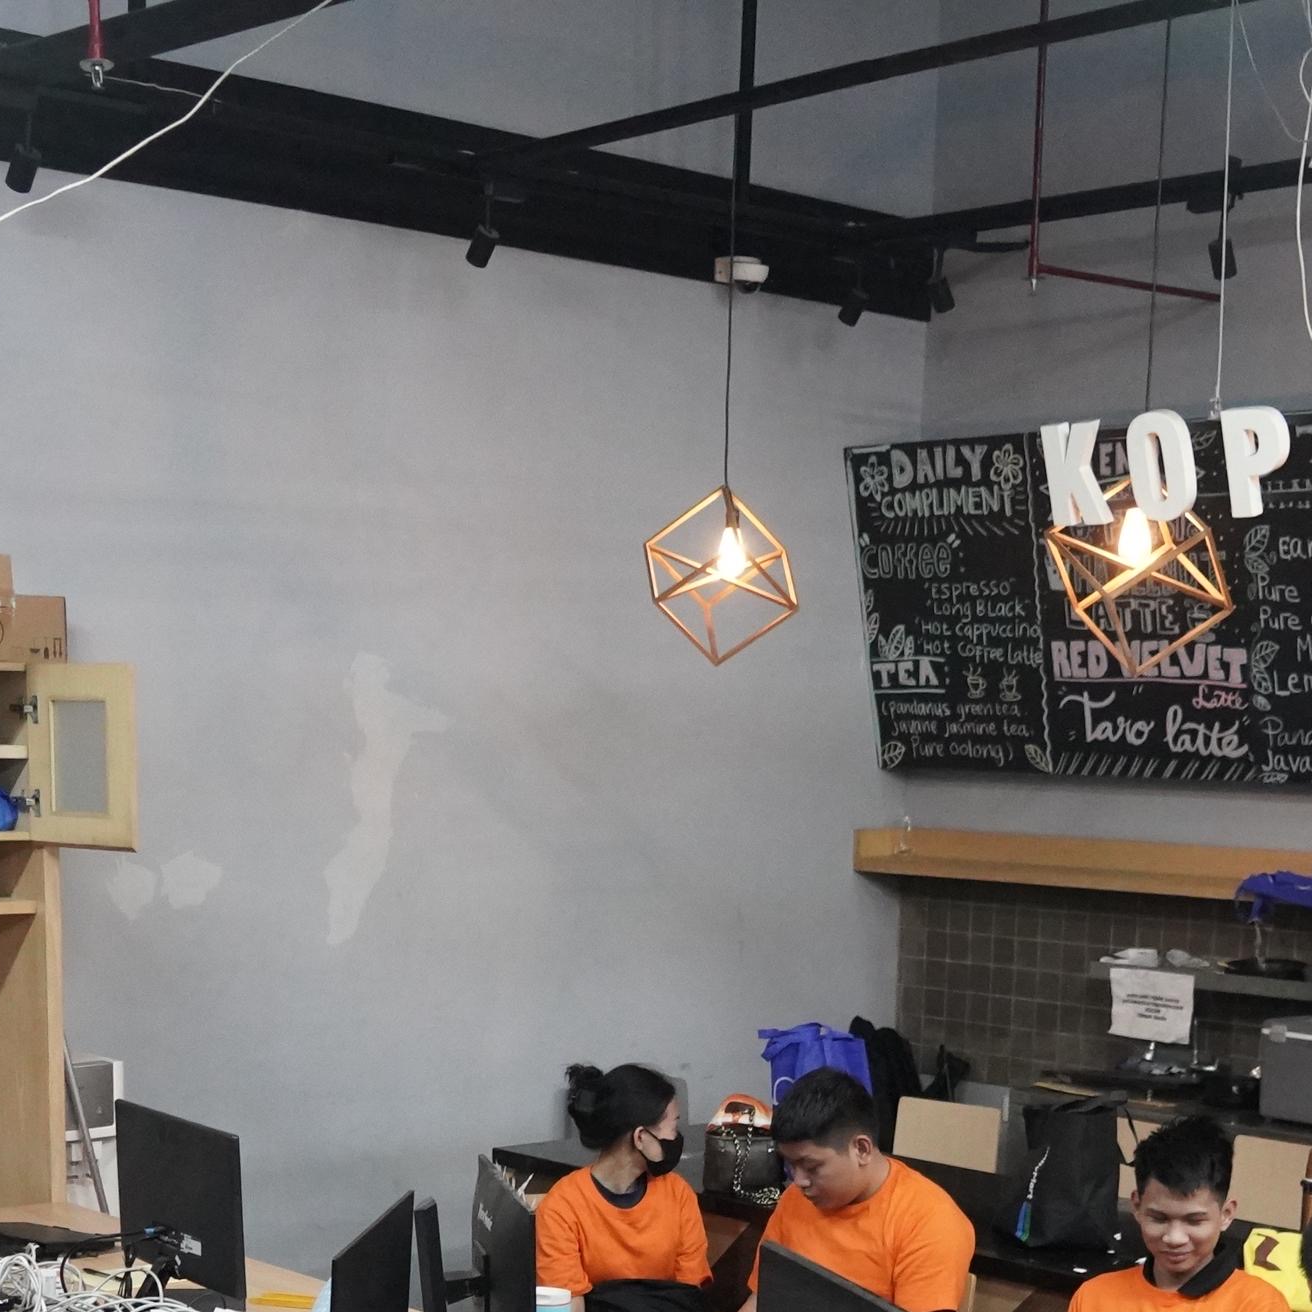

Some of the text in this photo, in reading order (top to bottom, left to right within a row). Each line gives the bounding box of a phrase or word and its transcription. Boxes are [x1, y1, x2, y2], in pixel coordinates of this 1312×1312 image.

[891, 445, 987, 488] DAILY
[881, 485, 1015, 518] COMPLIMENT
[1256, 572, 1301, 603] Pure
[1259, 606, 1302, 630] Pure
[1050, 639, 1248, 686] RED VELVET
[956, 702, 993, 722] green
